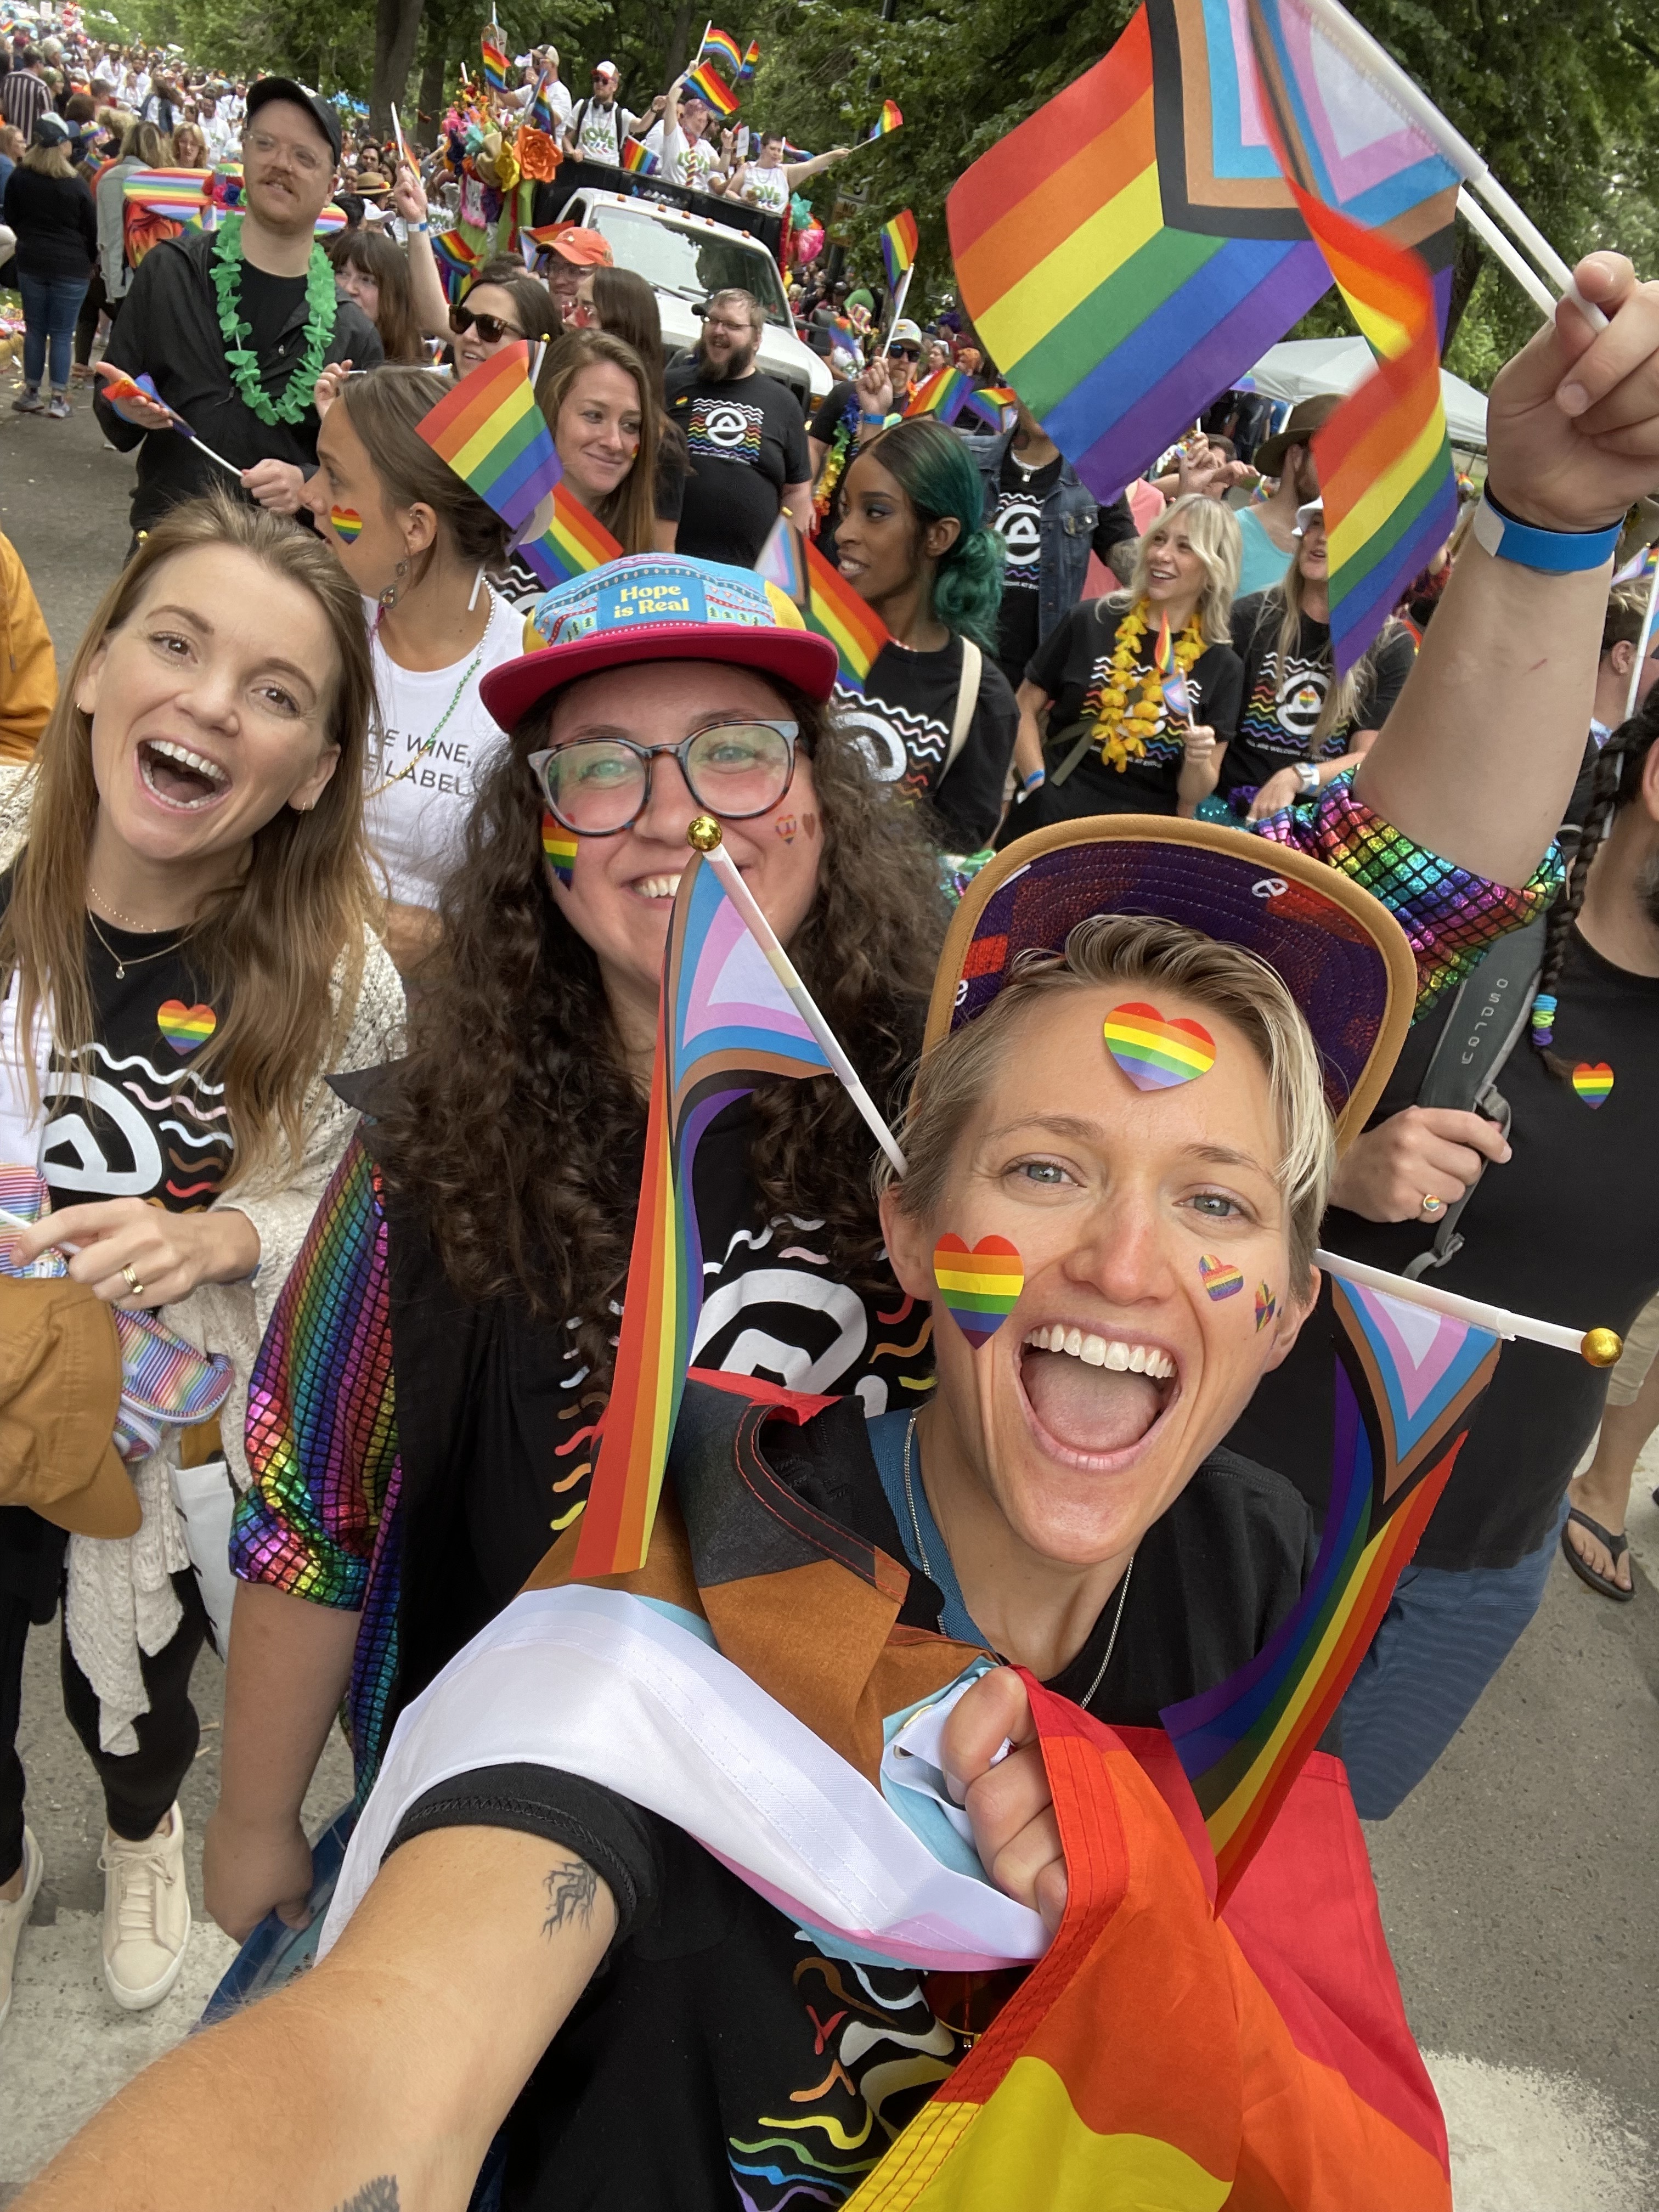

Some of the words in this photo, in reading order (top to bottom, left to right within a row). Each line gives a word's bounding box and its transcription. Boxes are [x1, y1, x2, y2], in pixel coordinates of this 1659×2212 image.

[753, 185, 781, 205] OVE
[620, 585, 682, 602] Hope
[614, 605, 634, 618] is
[638, 597, 690, 614] Real
[407, 734, 471, 768] WINE,
